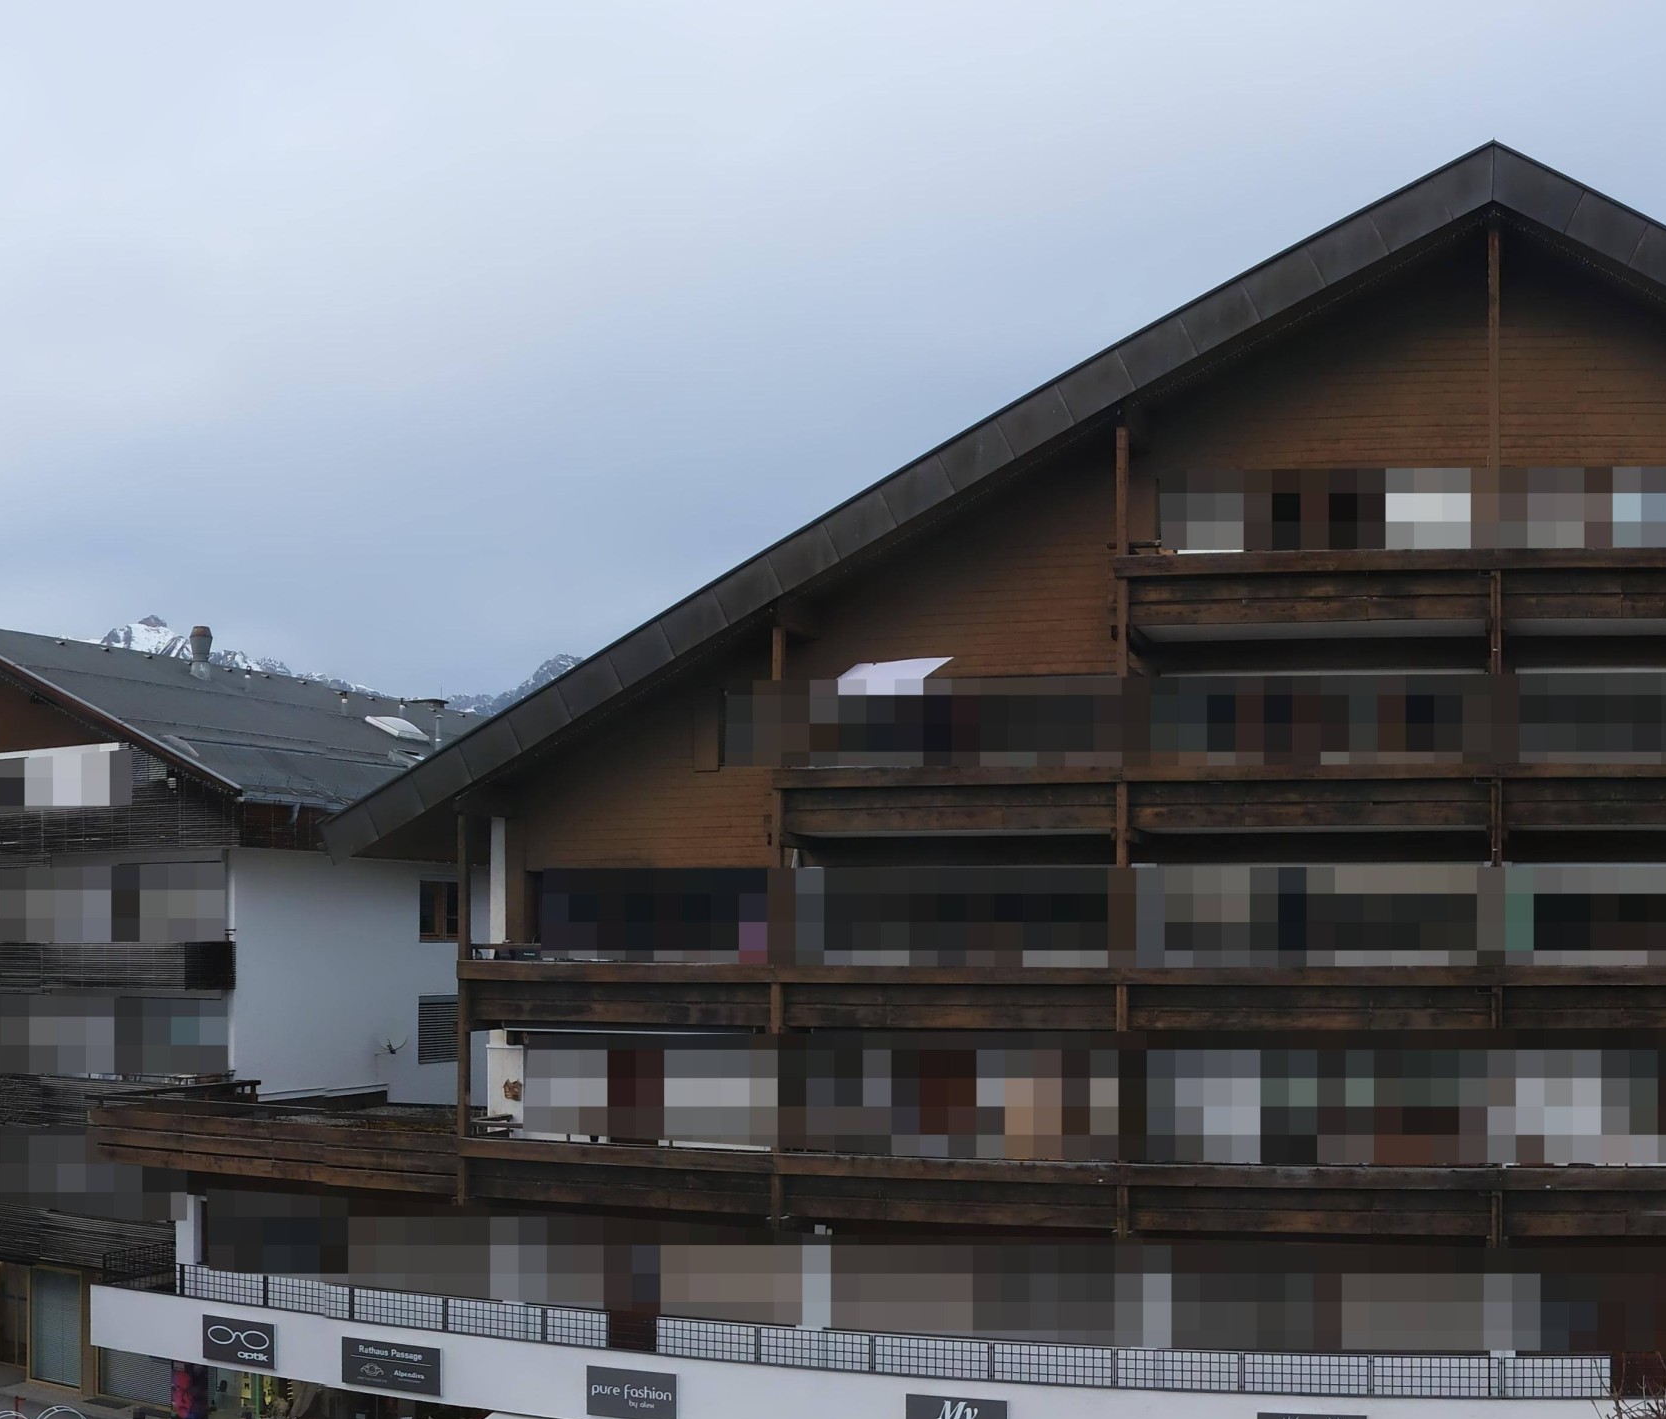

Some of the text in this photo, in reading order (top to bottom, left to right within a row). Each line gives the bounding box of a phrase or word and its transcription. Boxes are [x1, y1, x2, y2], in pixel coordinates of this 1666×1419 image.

[237, 1350, 269, 1362] optik
[358, 1344, 423, 1361] Rathaus Passage
[591, 1384, 672, 1401] pure fashion
[628, 1399, 638, 1410] by
